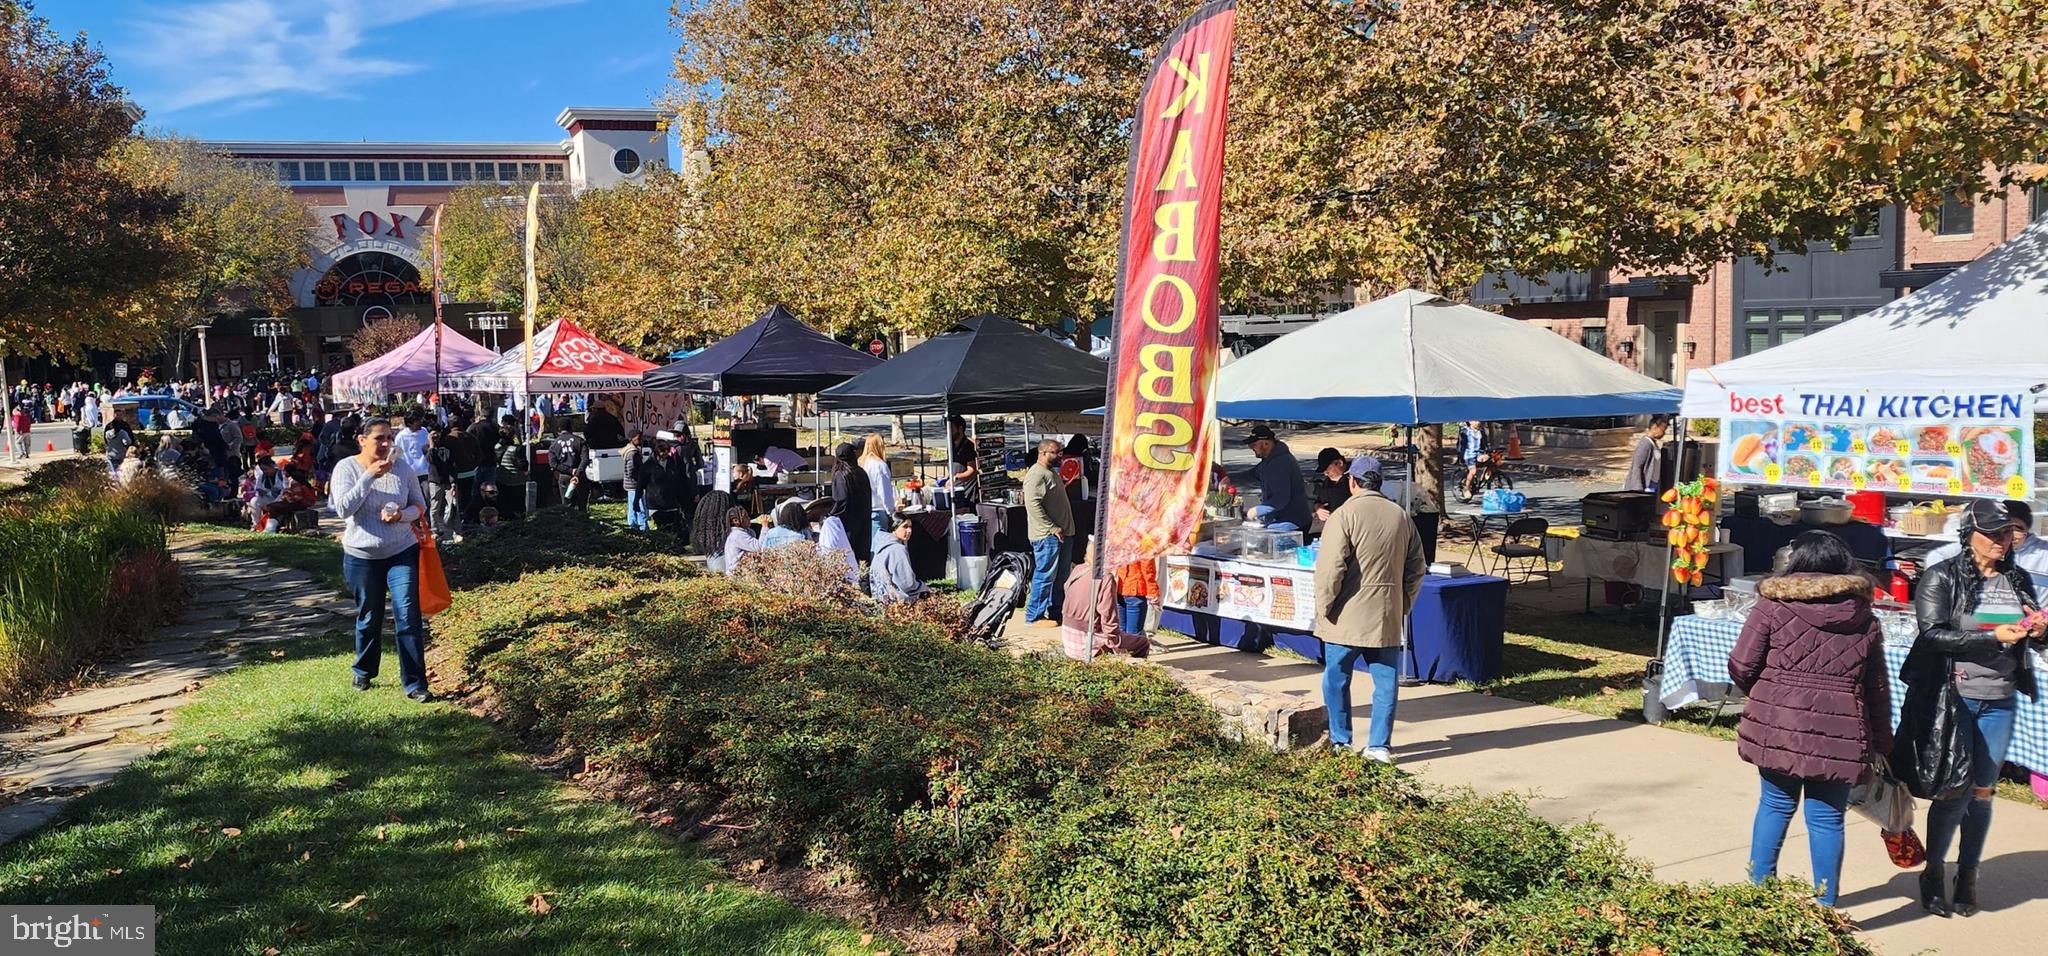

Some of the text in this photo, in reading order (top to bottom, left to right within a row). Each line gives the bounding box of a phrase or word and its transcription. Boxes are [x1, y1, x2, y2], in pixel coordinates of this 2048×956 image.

[330, 211, 405, 240] FOX
[347, 281, 424, 294] REGA
[559, 337, 599, 354] my
[1730, 391, 2023, 418] best THAI KITCHEN
